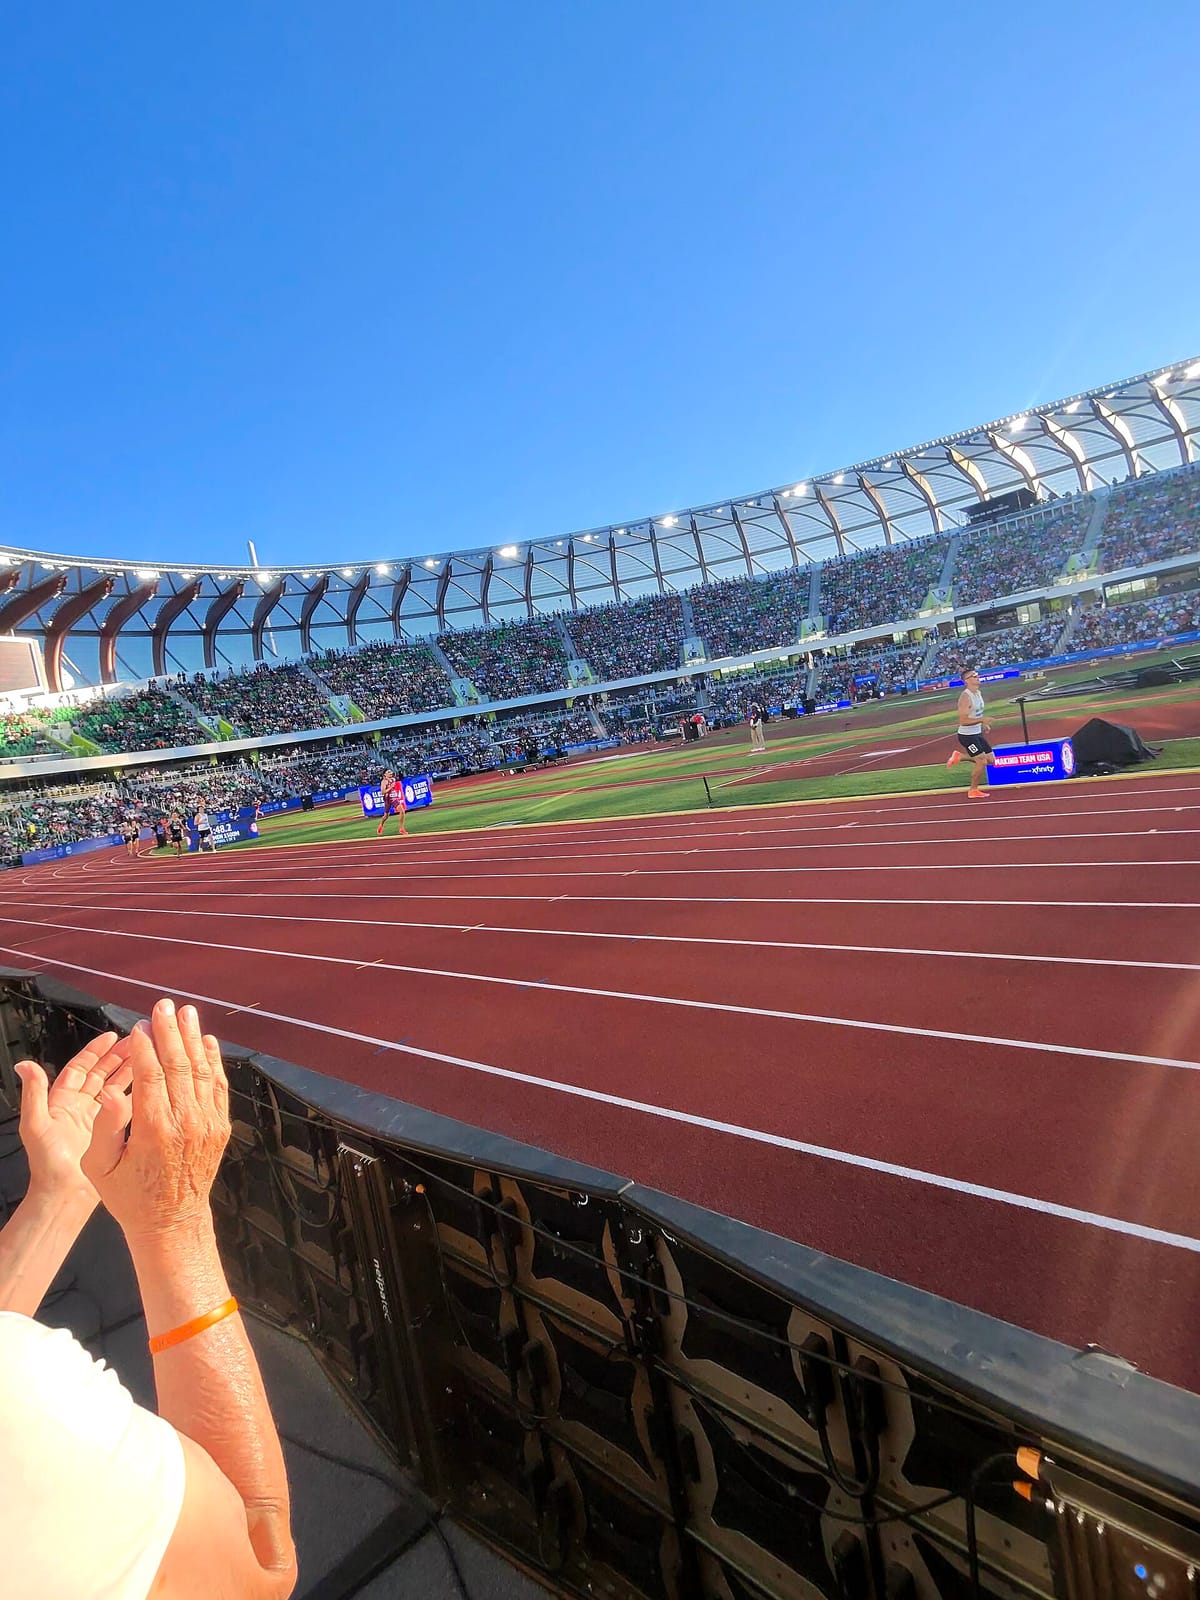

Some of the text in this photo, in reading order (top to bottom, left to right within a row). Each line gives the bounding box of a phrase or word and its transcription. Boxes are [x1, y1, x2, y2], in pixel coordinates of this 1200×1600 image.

[994, 753, 1051, 766] MAKING TEAM USA
[1031, 765, 1054, 774] xfinity
